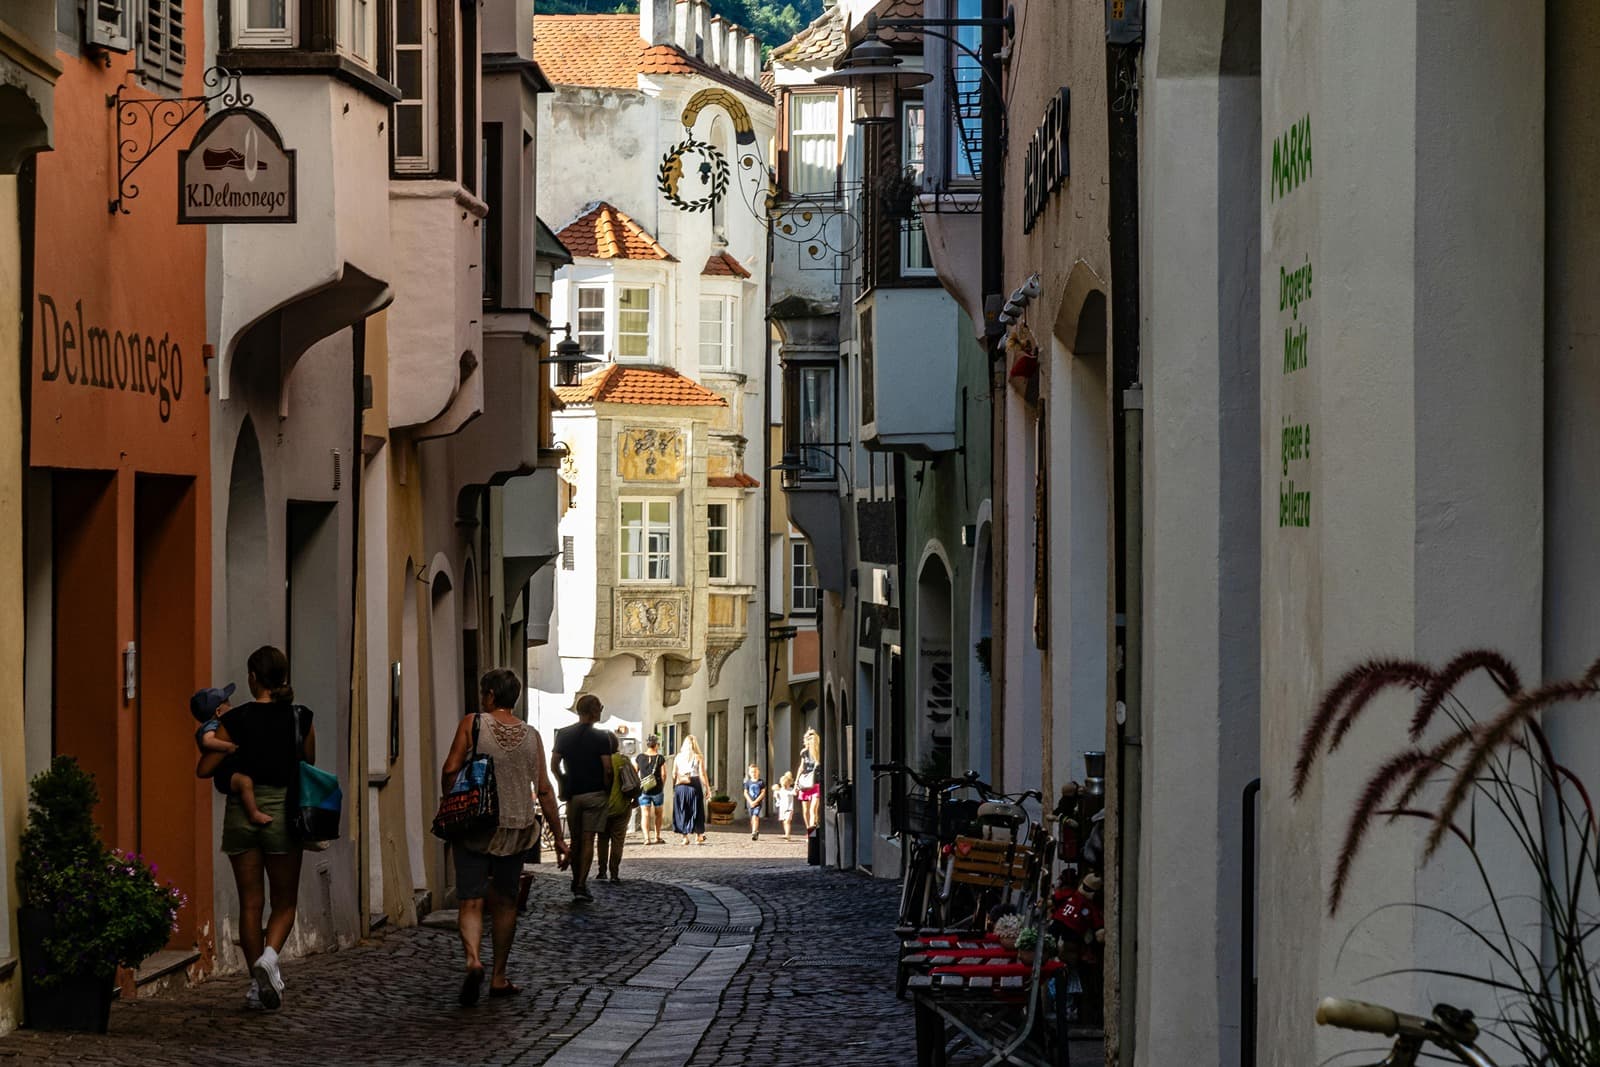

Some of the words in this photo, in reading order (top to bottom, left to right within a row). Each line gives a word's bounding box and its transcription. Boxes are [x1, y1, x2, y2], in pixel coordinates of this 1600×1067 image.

[1271, 112, 1312, 204] MARKA
[186, 183, 286, 213] K.Delmonego
[1280, 252, 1312, 320] Drogerie
[38, 294, 183, 423] Delmonego
[1283, 323, 1308, 374] Markt
[1281, 414, 1302, 476] igiene
[1305, 424, 1310, 459] e
[1280, 480, 1310, 528] bellezza
